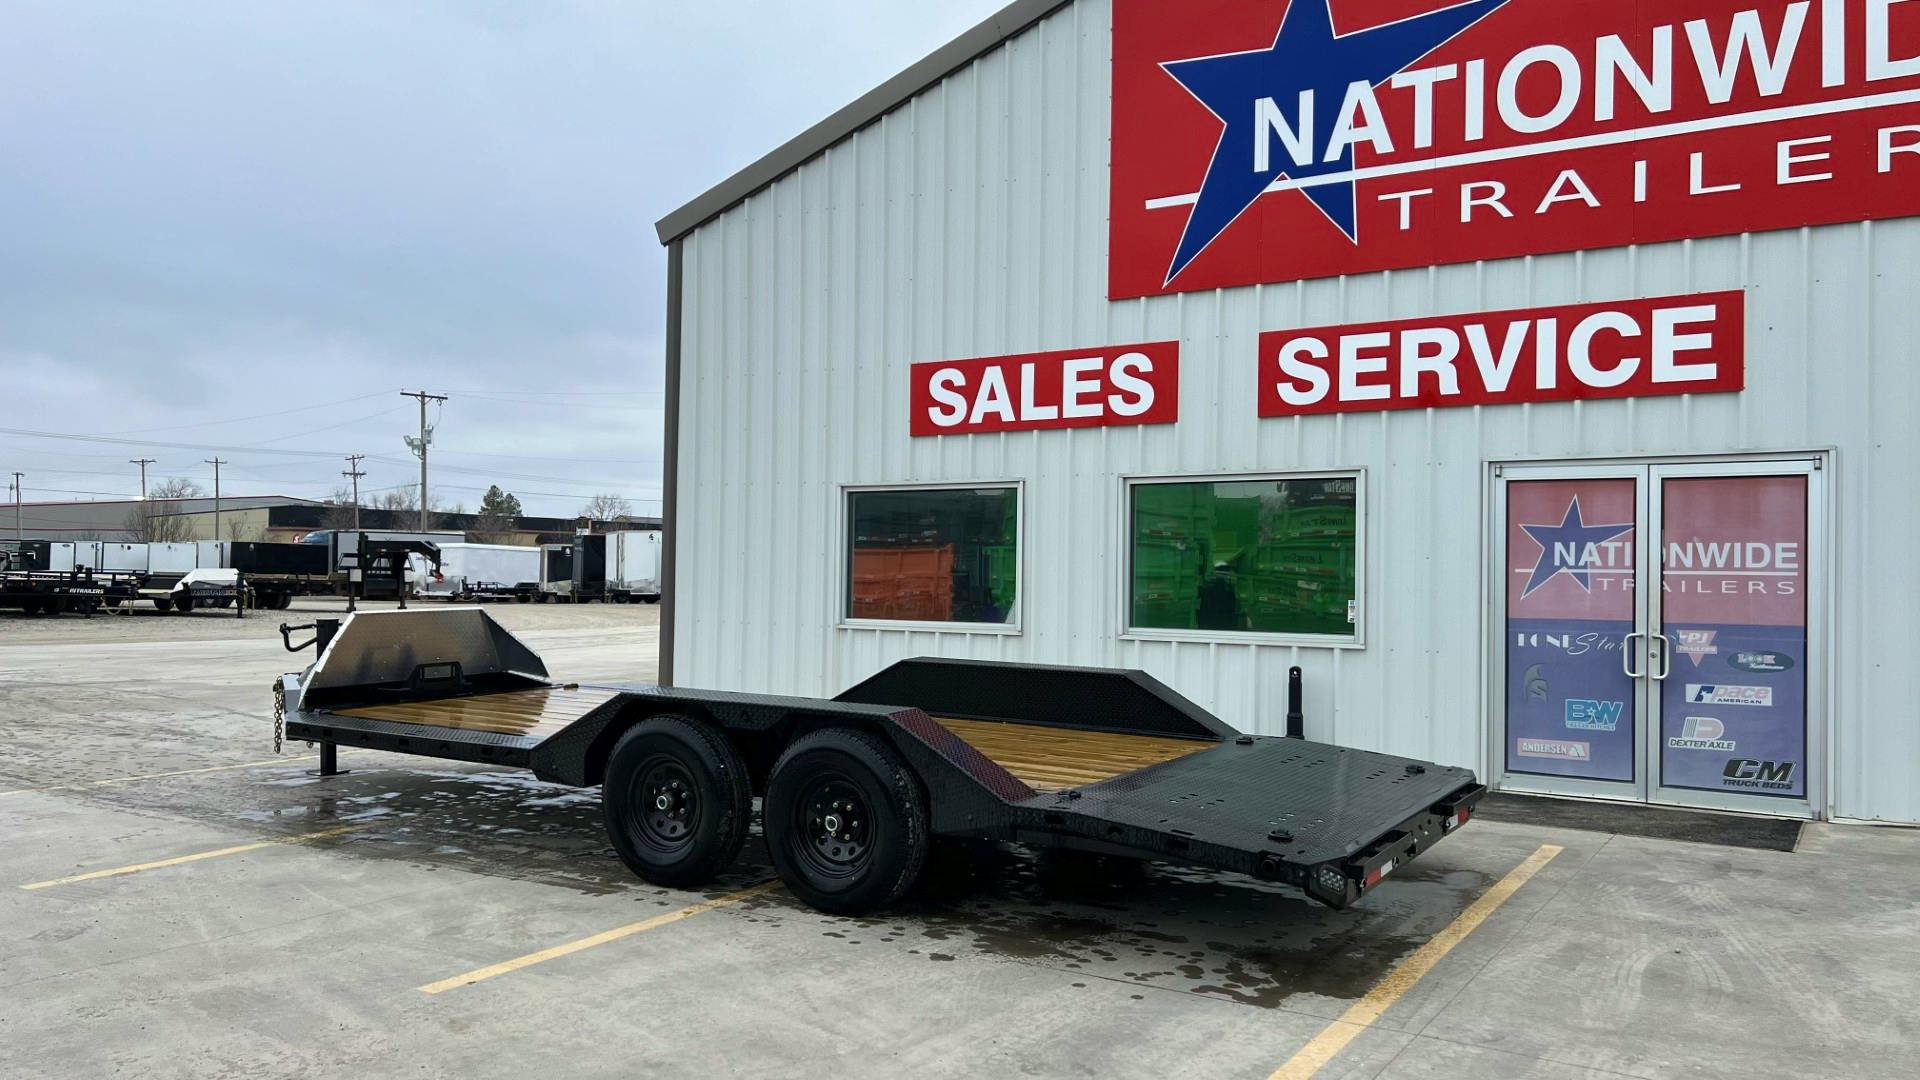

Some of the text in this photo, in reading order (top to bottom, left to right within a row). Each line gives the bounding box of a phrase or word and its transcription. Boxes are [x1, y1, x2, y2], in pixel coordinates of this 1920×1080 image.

[1276, 304, 1717, 405] SERVICE
[927, 352, 1155, 427] SALES
[1553, 541, 1799, 569] NATINWIDE
[1687, 632, 1709, 643] PJ
[1522, 743, 1567, 754] ANDERSEN
[1670, 739, 1734, 750] DEXTER AXLE
[1723, 759, 1796, 781] CM
[1723, 779, 1793, 790] TRUCK BEDS
